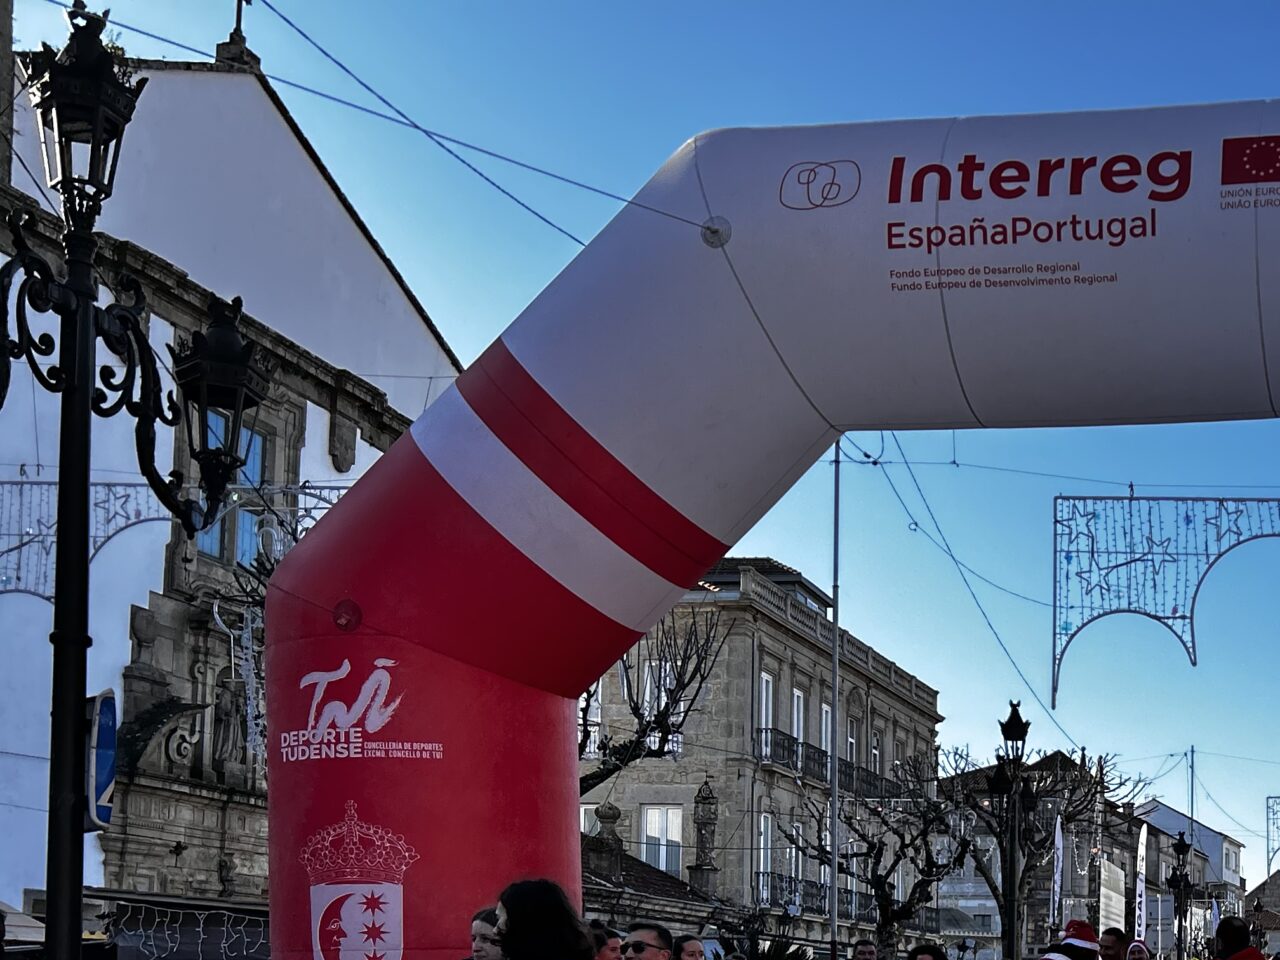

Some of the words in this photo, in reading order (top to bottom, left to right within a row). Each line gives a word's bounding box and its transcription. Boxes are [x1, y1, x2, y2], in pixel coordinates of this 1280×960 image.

[888, 150, 1192, 204] Interreg
[1220, 187, 1252, 198] UNIÓN
[1220, 199, 1251, 210] UNIÃO
[887, 208, 1157, 254] EspañaPortugal
[890, 268, 921, 279] Fondo
[924, 266, 966, 278] Europeo
[968, 265, 981, 276] de
[984, 263, 1034, 276] Desarrollo
[1036, 261, 1081, 274] Regional
[891, 281, 923, 292] Fundo
[925, 279, 967, 291] Europeu
[969, 278, 982, 289] de
[984, 275, 1072, 288] Desenvolvimento
[1074, 272, 1118, 285] Regional
[280, 727, 363, 747] DEPORTE
[280, 743, 363, 763] TUDENSE
[388, 751, 421, 759] CONCELLO
[422, 751, 431, 759] DE
[432, 751, 443, 760] TUI
[404, 742, 411, 751] DE
[413, 742, 443, 752] DEPORTES
